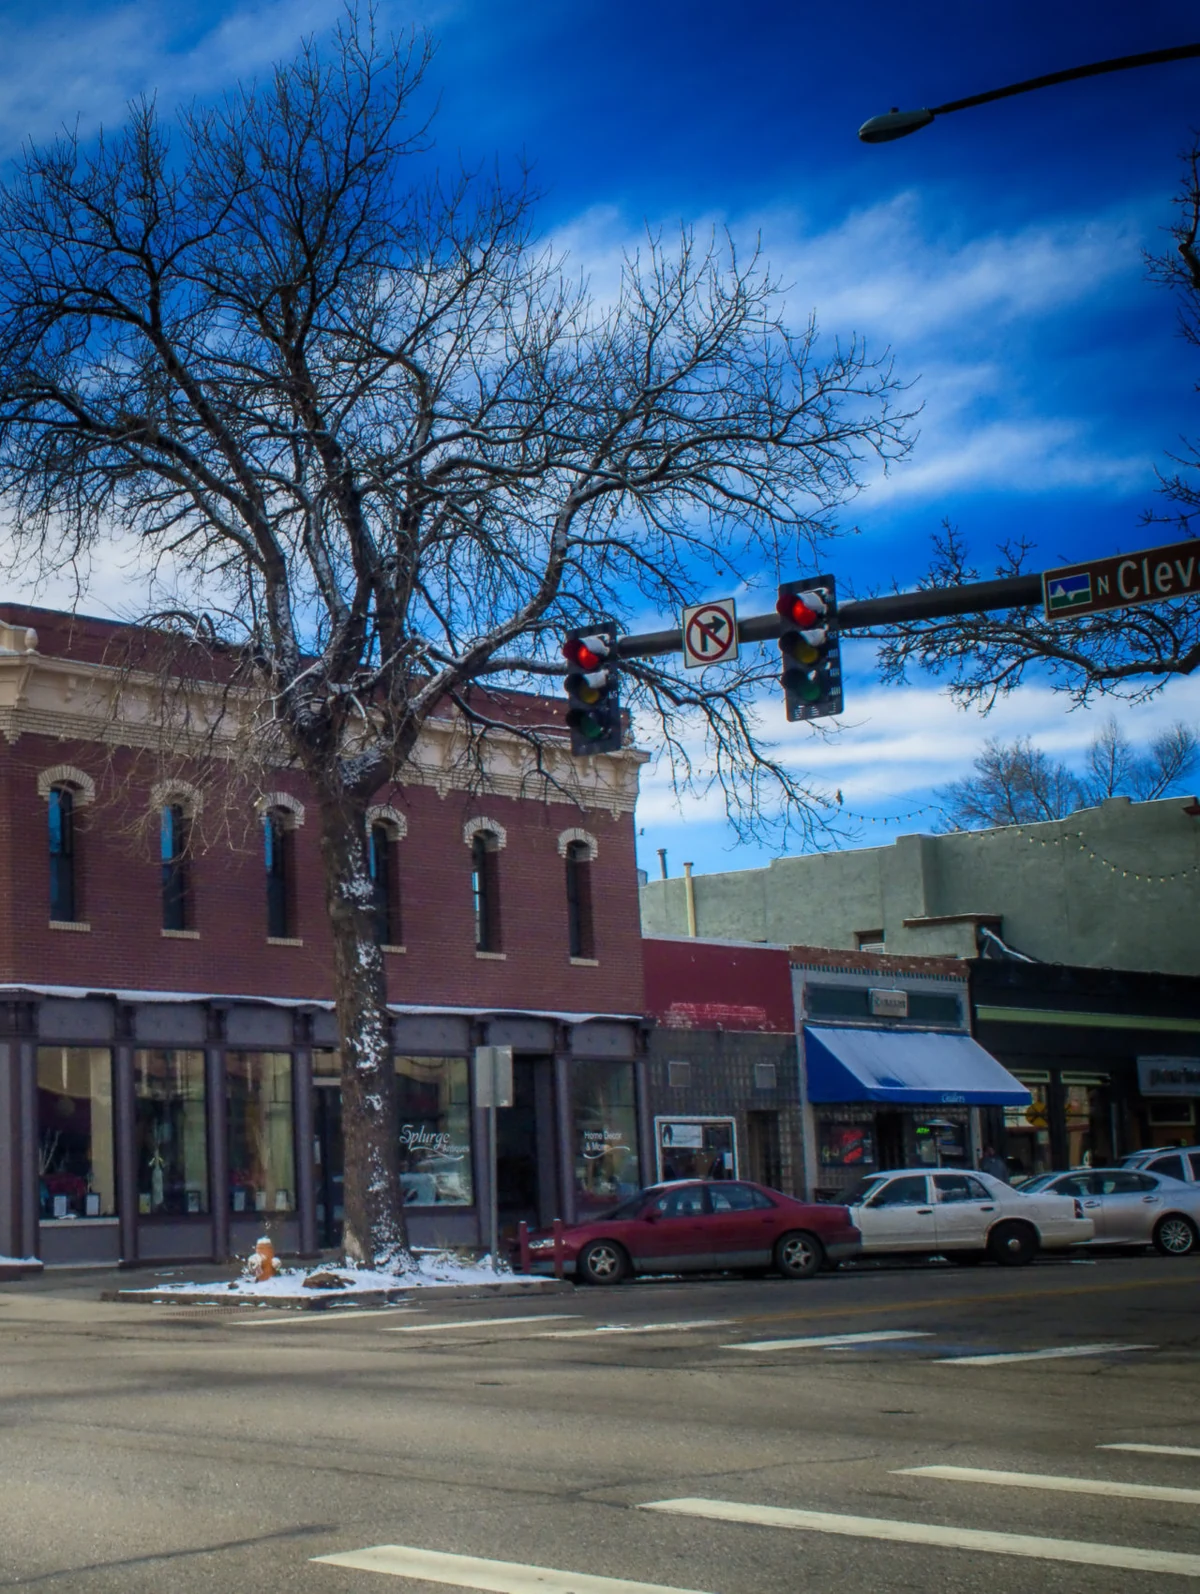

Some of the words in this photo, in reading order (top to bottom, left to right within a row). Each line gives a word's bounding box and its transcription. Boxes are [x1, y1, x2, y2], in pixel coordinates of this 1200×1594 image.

[1097, 575, 1110, 596] N
[1117, 556, 1200, 599] Clev
[399, 1124, 450, 1150] Splurge
[584, 1131, 603, 1140] Home
[585, 1142, 590, 1151] &
